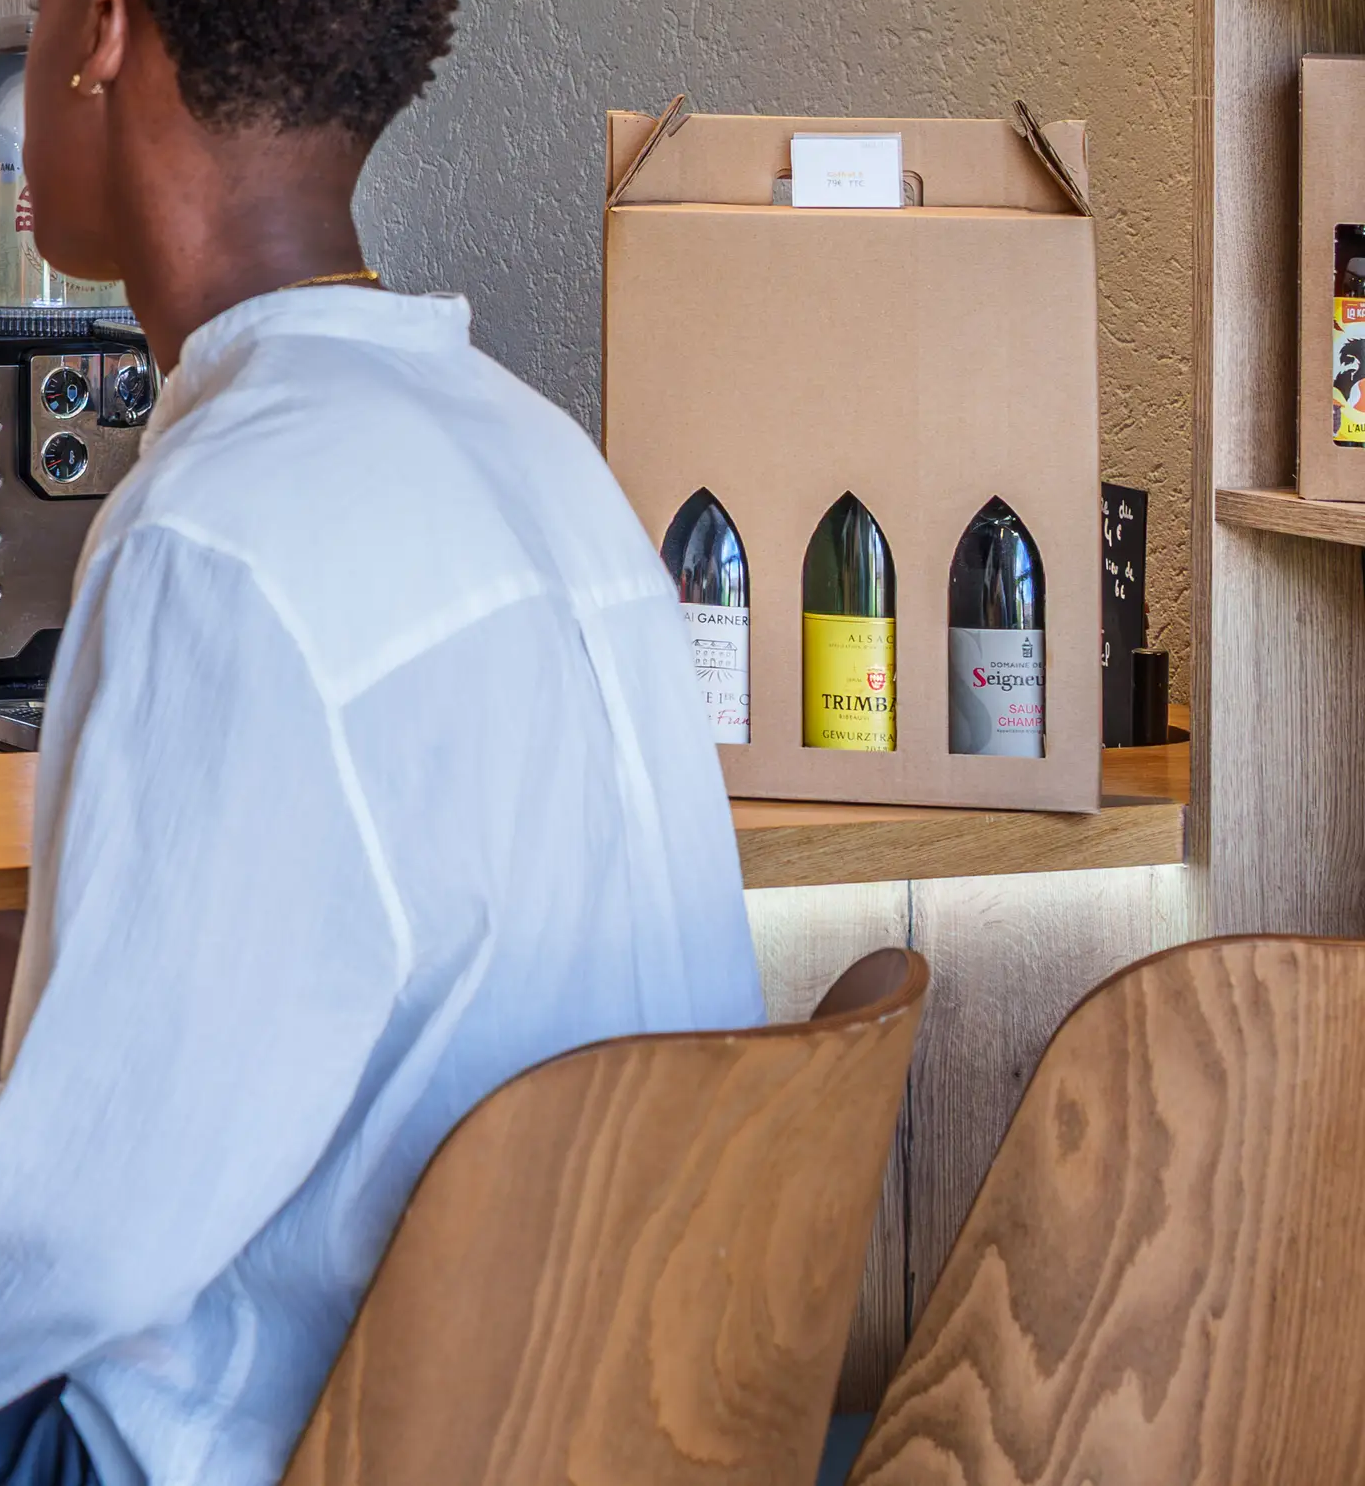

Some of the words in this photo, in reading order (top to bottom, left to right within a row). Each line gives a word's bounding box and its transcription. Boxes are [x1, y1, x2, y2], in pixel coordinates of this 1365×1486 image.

[990, 661, 1029, 669] DOMAINE
[998, 717, 1042, 727] CHAMP
[822, 729, 895, 743] GEWURZTRA
